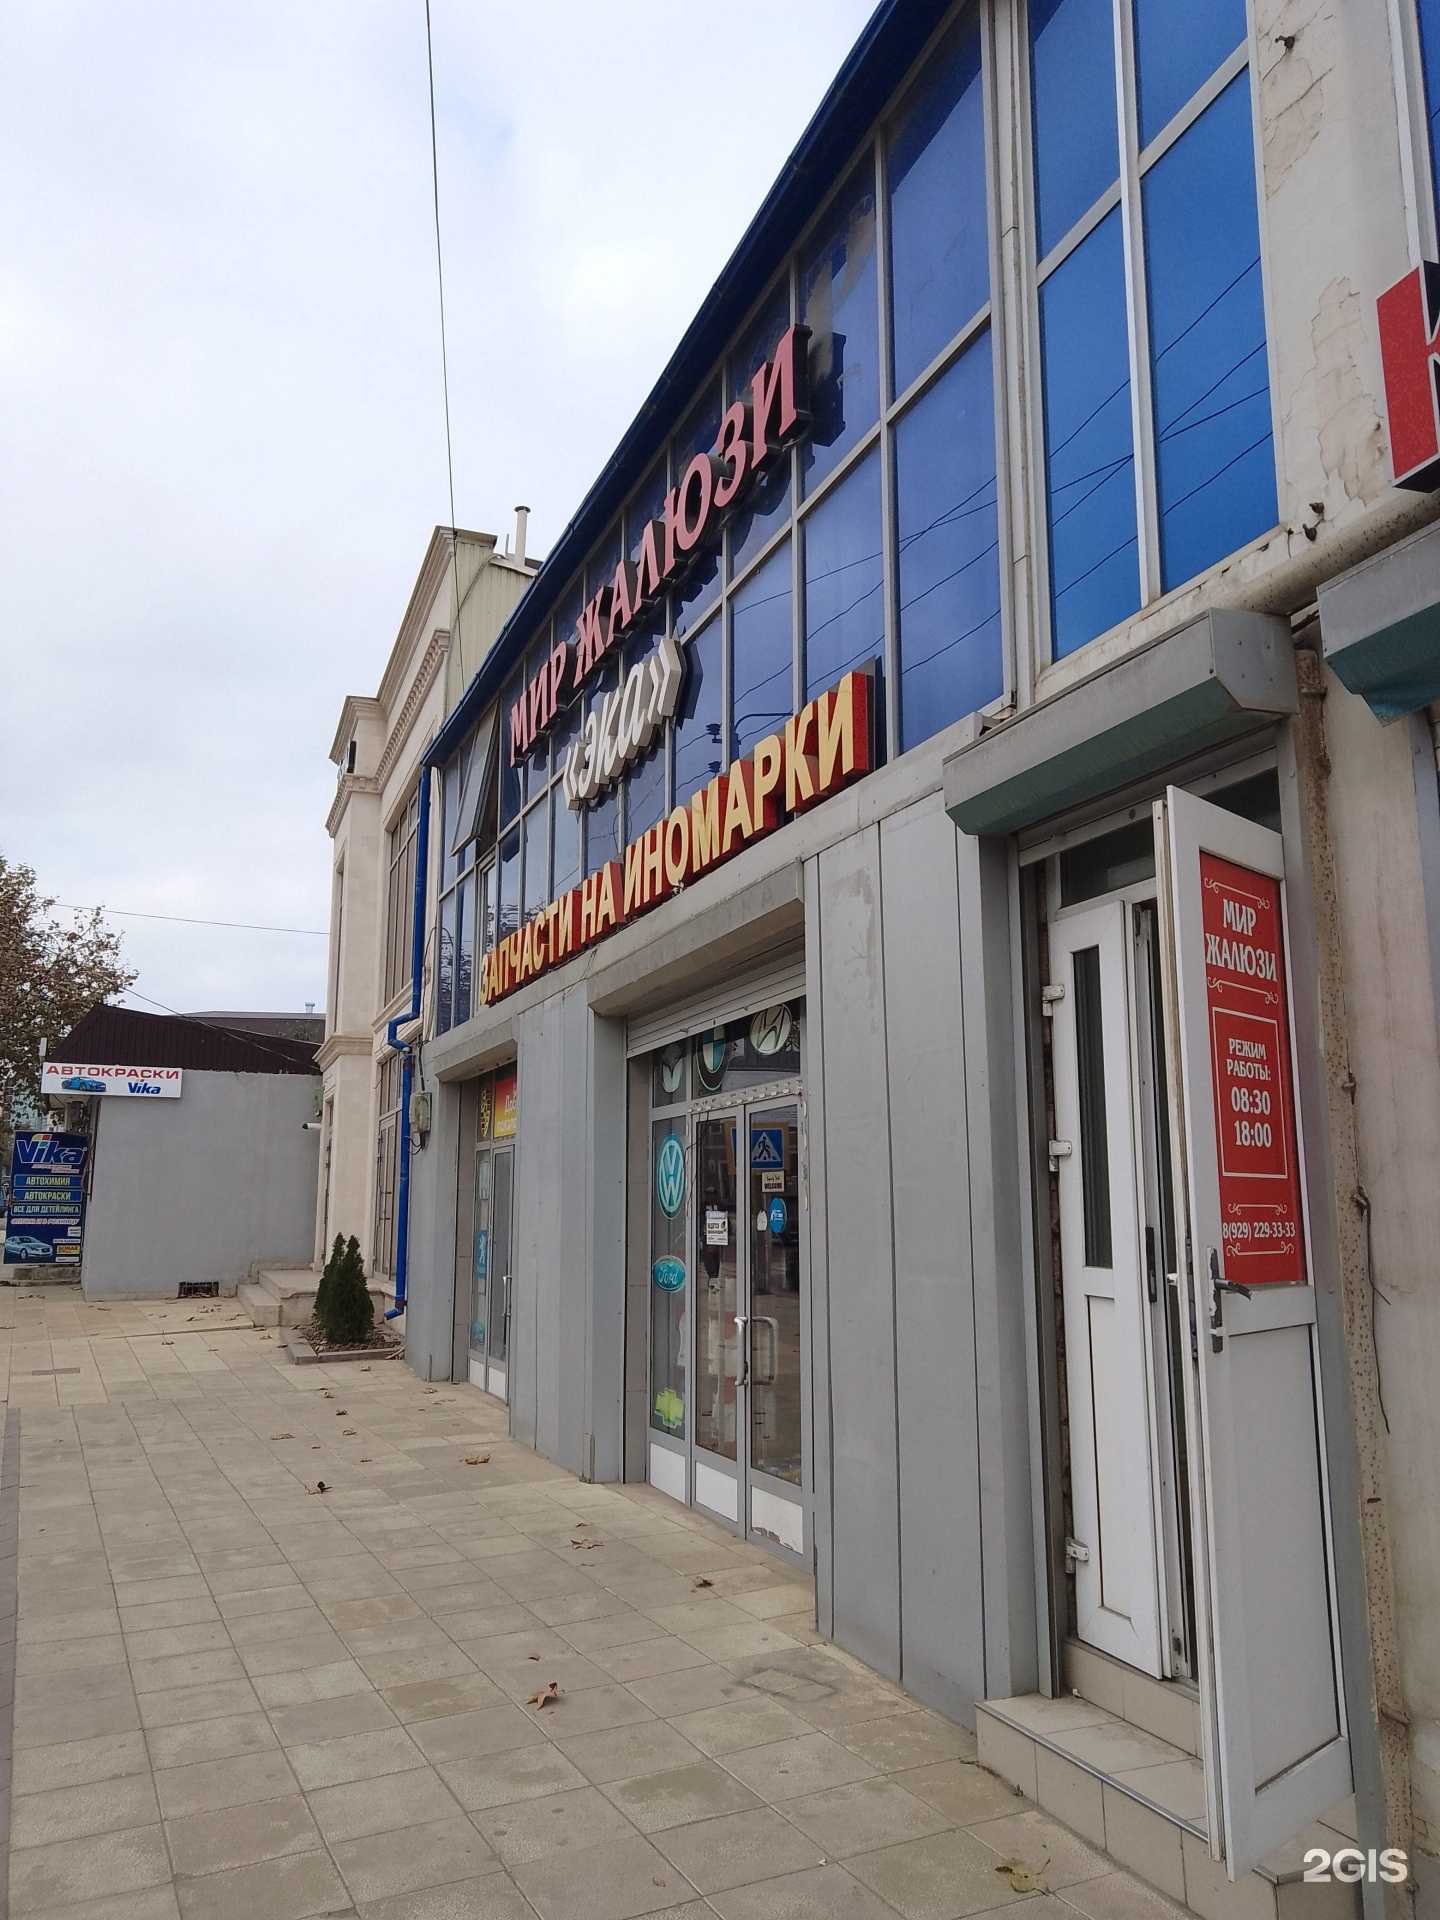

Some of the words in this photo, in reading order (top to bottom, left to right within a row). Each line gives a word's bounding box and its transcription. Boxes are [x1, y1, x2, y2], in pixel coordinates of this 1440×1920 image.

[510, 641, 567, 768] МИР
[573, 326, 797, 688] ЖАЛЮЗИ
[480, 888, 573, 1007] ЗАПЧАСТИ
[580, 860, 617, 944] НА
[624, 671, 855, 916] ИНОМАРКИ
[1223, 898, 1257, 937] МИР
[1205, 932, 1278, 982] ЖАЛЮЗИ
[1228, 1038, 1267, 1060] РЕЖИМ
[46, 1065, 180, 1080] АВТОКРАСКИ
[1226, 1059, 1272, 1080] РАБОТЫ:
[127, 1079, 161, 1095] Vika
[1231, 1086, 1271, 1115] 08:30
[1234, 1120, 1272, 1148] 18:00
[16, 1134, 84, 1164] Vika
[26, 1176, 71, 1186] АВТОХИМИЯ
[24, 1191, 72, 1201] АВТОКРАСКИ
[1223, 1222, 1252, 1244] 8(929)
[1254, 1222, 1296, 1239] 229-33-33
